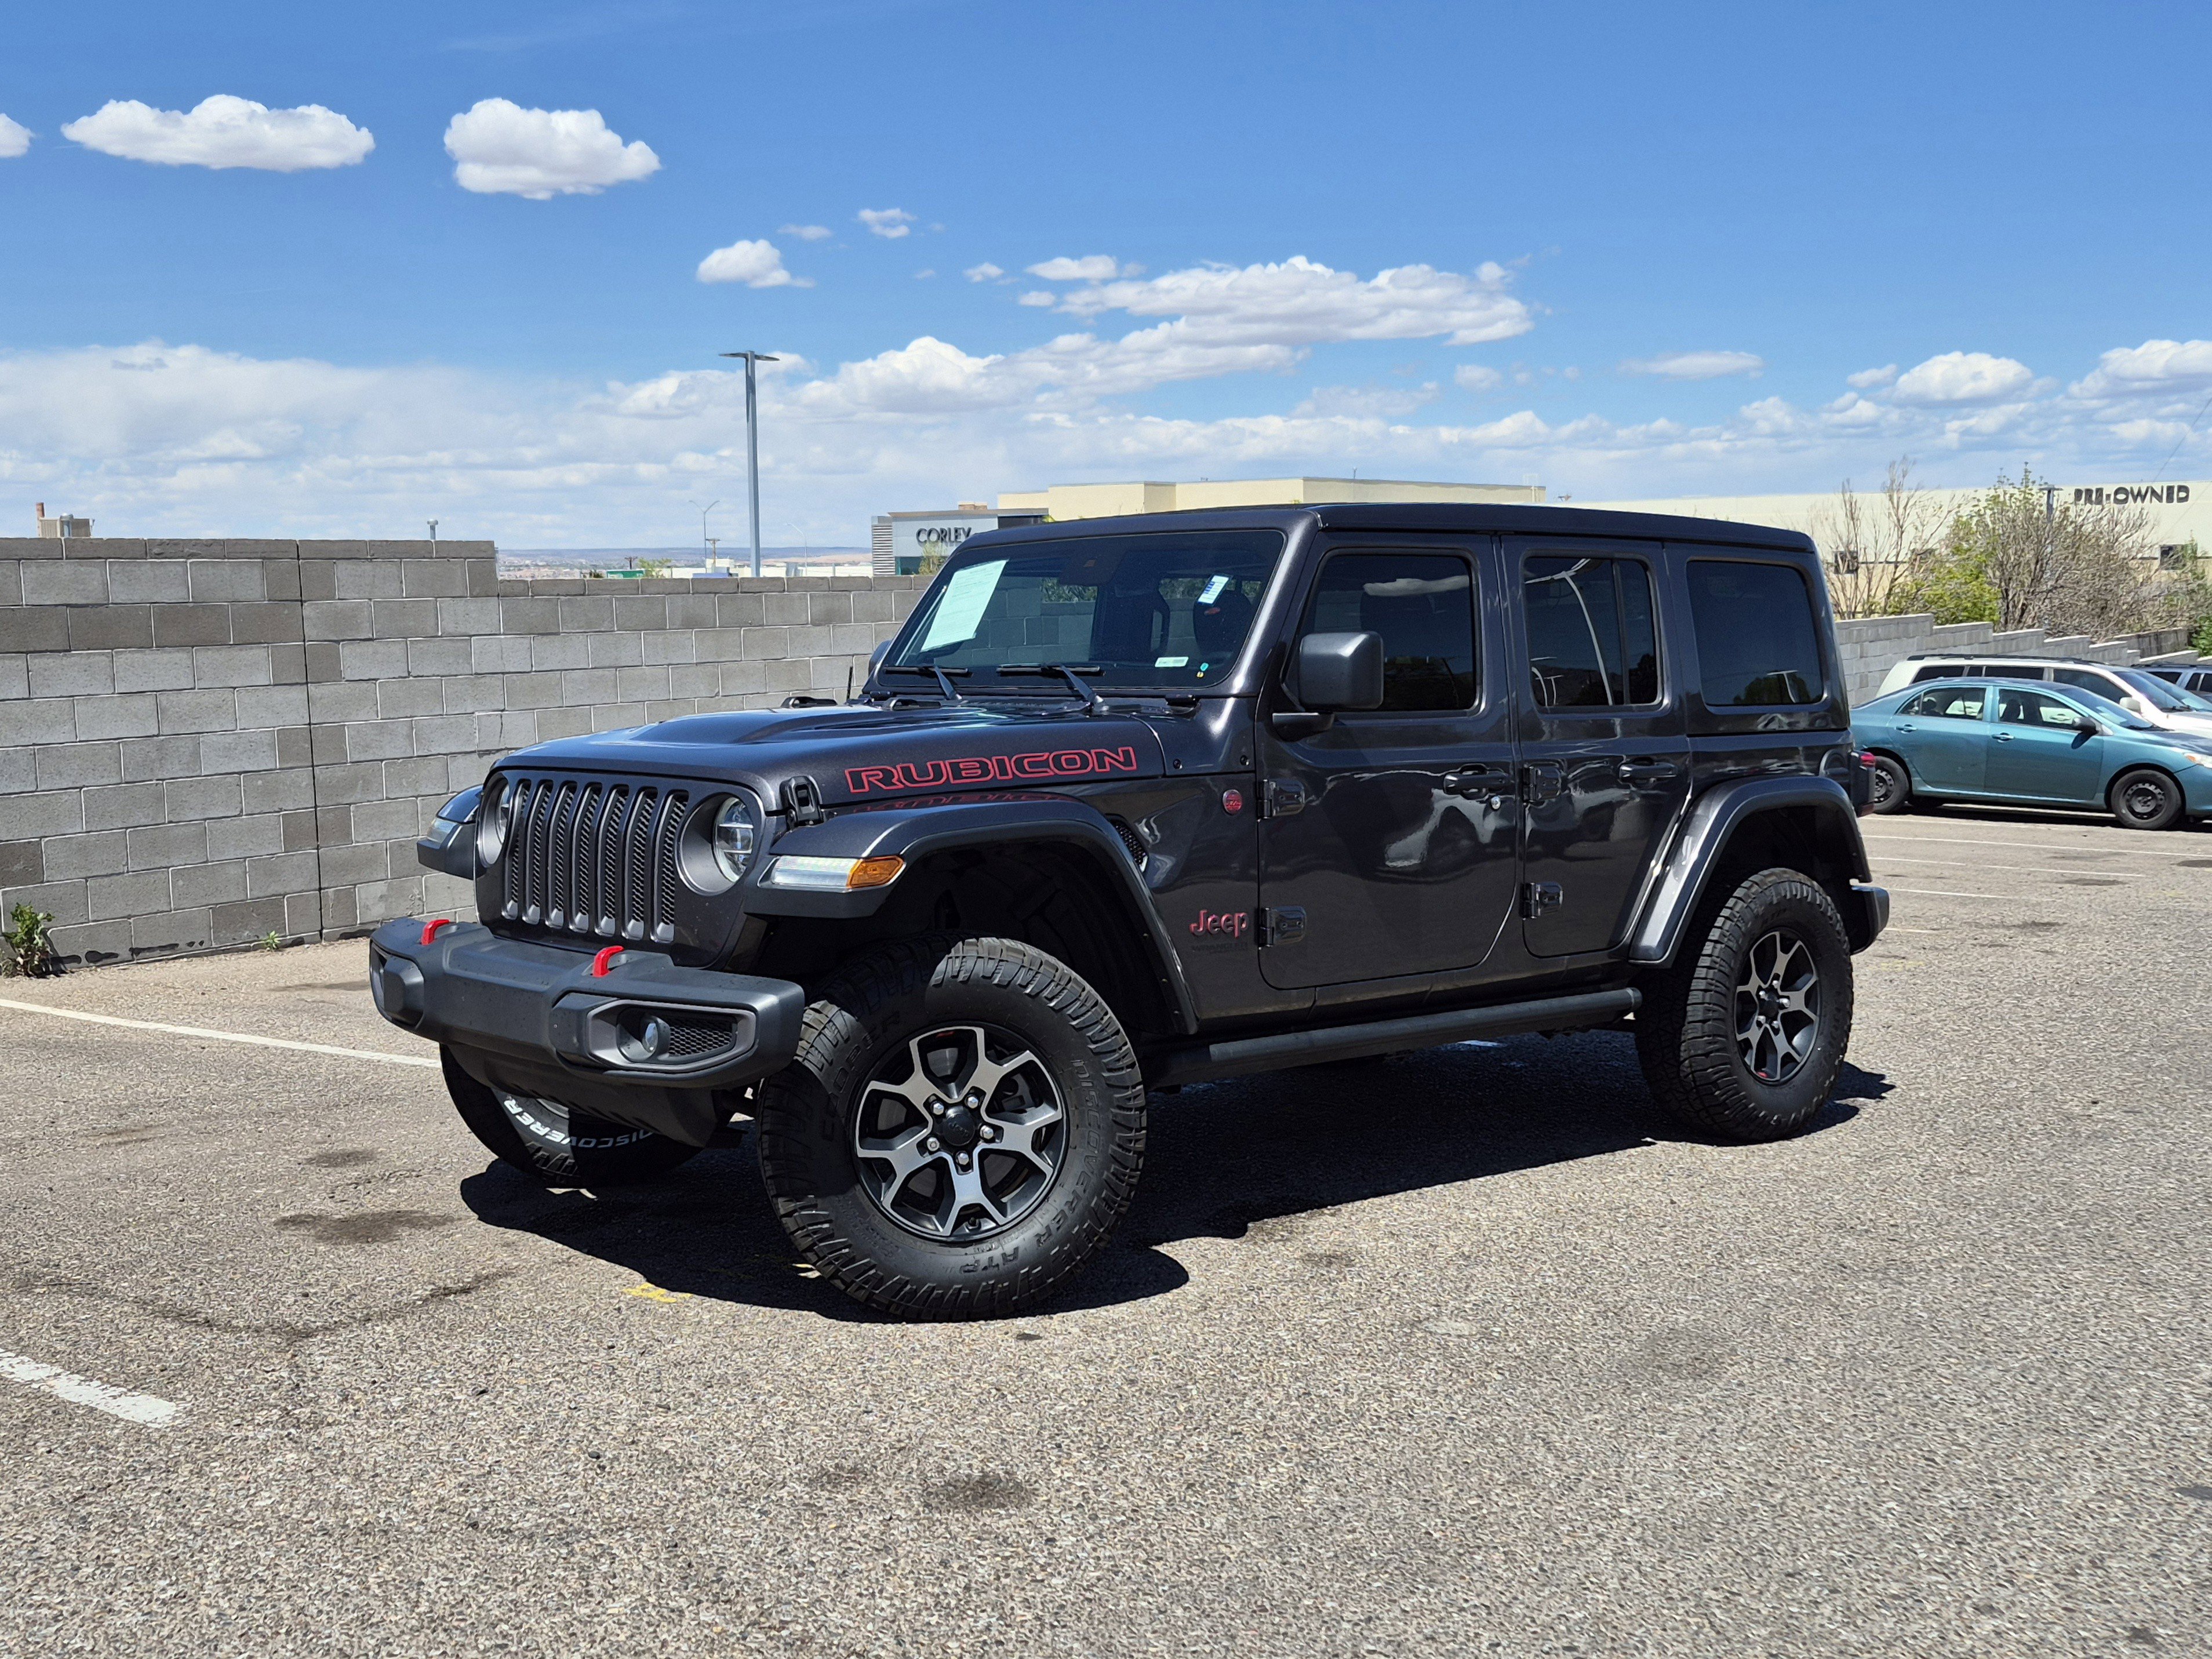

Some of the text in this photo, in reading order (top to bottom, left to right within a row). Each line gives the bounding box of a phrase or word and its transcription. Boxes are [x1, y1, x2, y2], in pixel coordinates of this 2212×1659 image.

[2074, 485, 2189, 505] PRE-OWNED
[916, 527, 972, 543] CORLEY
[845, 747, 1137, 792] RUBICON
[1189, 909, 1249, 938] Jeep
[1035, 1060, 1101, 1247] DISCOVERER
